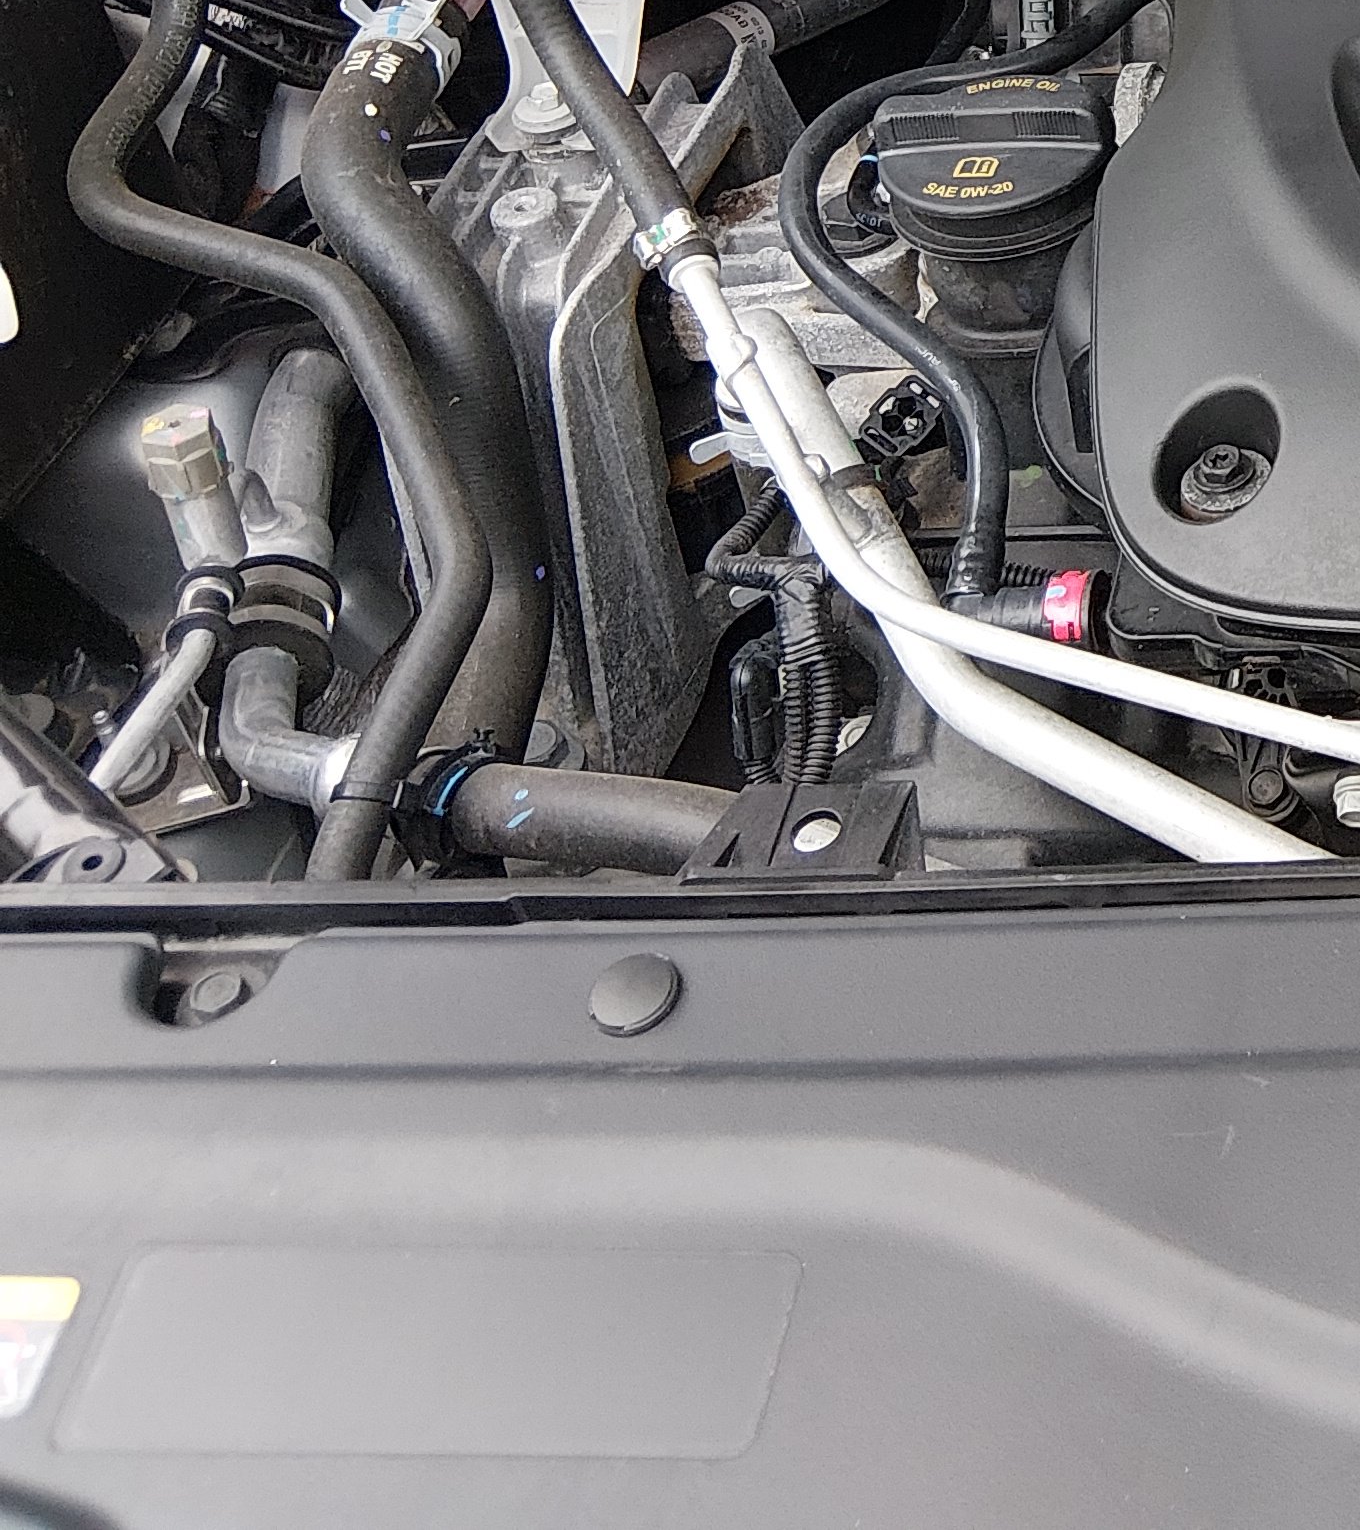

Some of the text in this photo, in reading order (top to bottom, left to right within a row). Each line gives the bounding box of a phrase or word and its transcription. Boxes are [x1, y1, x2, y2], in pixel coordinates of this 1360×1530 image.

[370, 52, 404, 84] HOT
[965, 77, 1062, 95] ENGINE OIL
[922, 181, 1014, 199] SAE 0W-20
